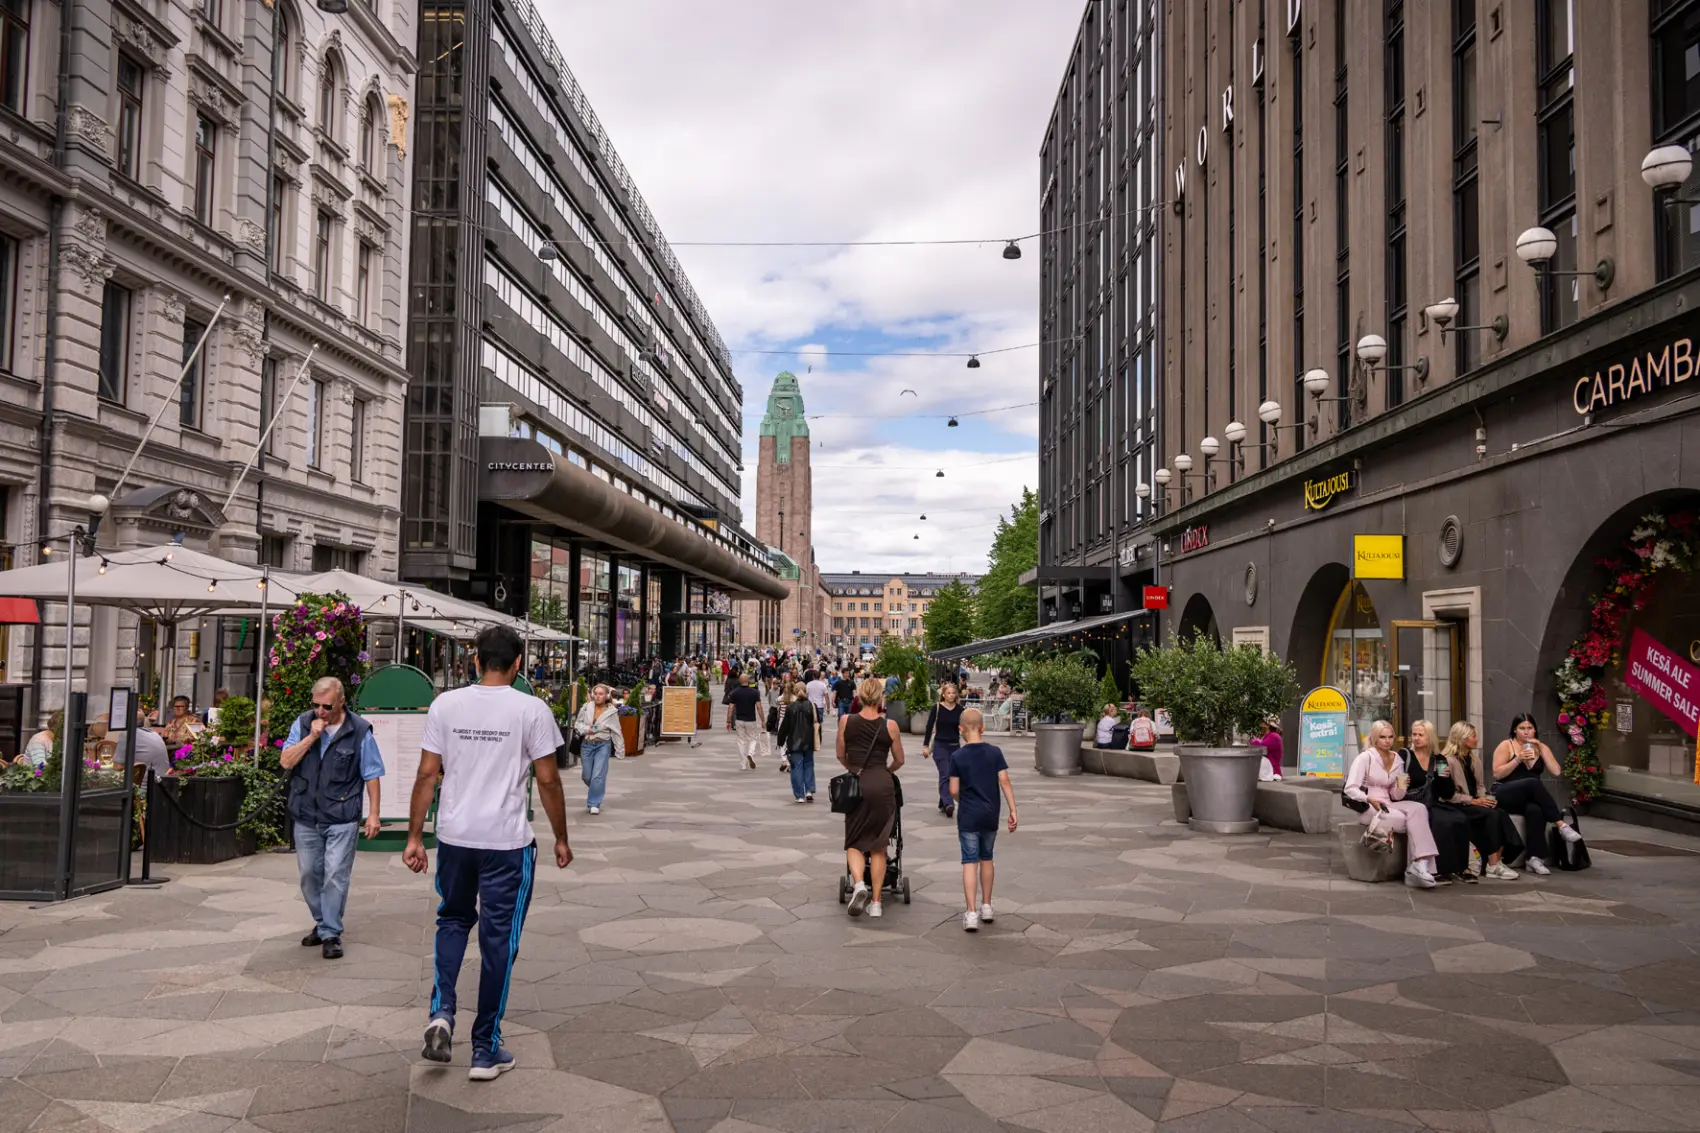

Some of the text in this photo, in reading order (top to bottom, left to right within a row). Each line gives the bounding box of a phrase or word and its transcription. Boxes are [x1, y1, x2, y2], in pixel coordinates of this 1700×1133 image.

[1573, 338, 1700, 415] CARAMB
[488, 462, 553, 470] CITYCENTER
[1181, 525, 1208, 553] LINDEX
[1647, 646, 1692, 689] KESÄ ALE
[1631, 661, 1699, 723] SUMMER SALE
[1310, 727, 1337, 738] extra!
